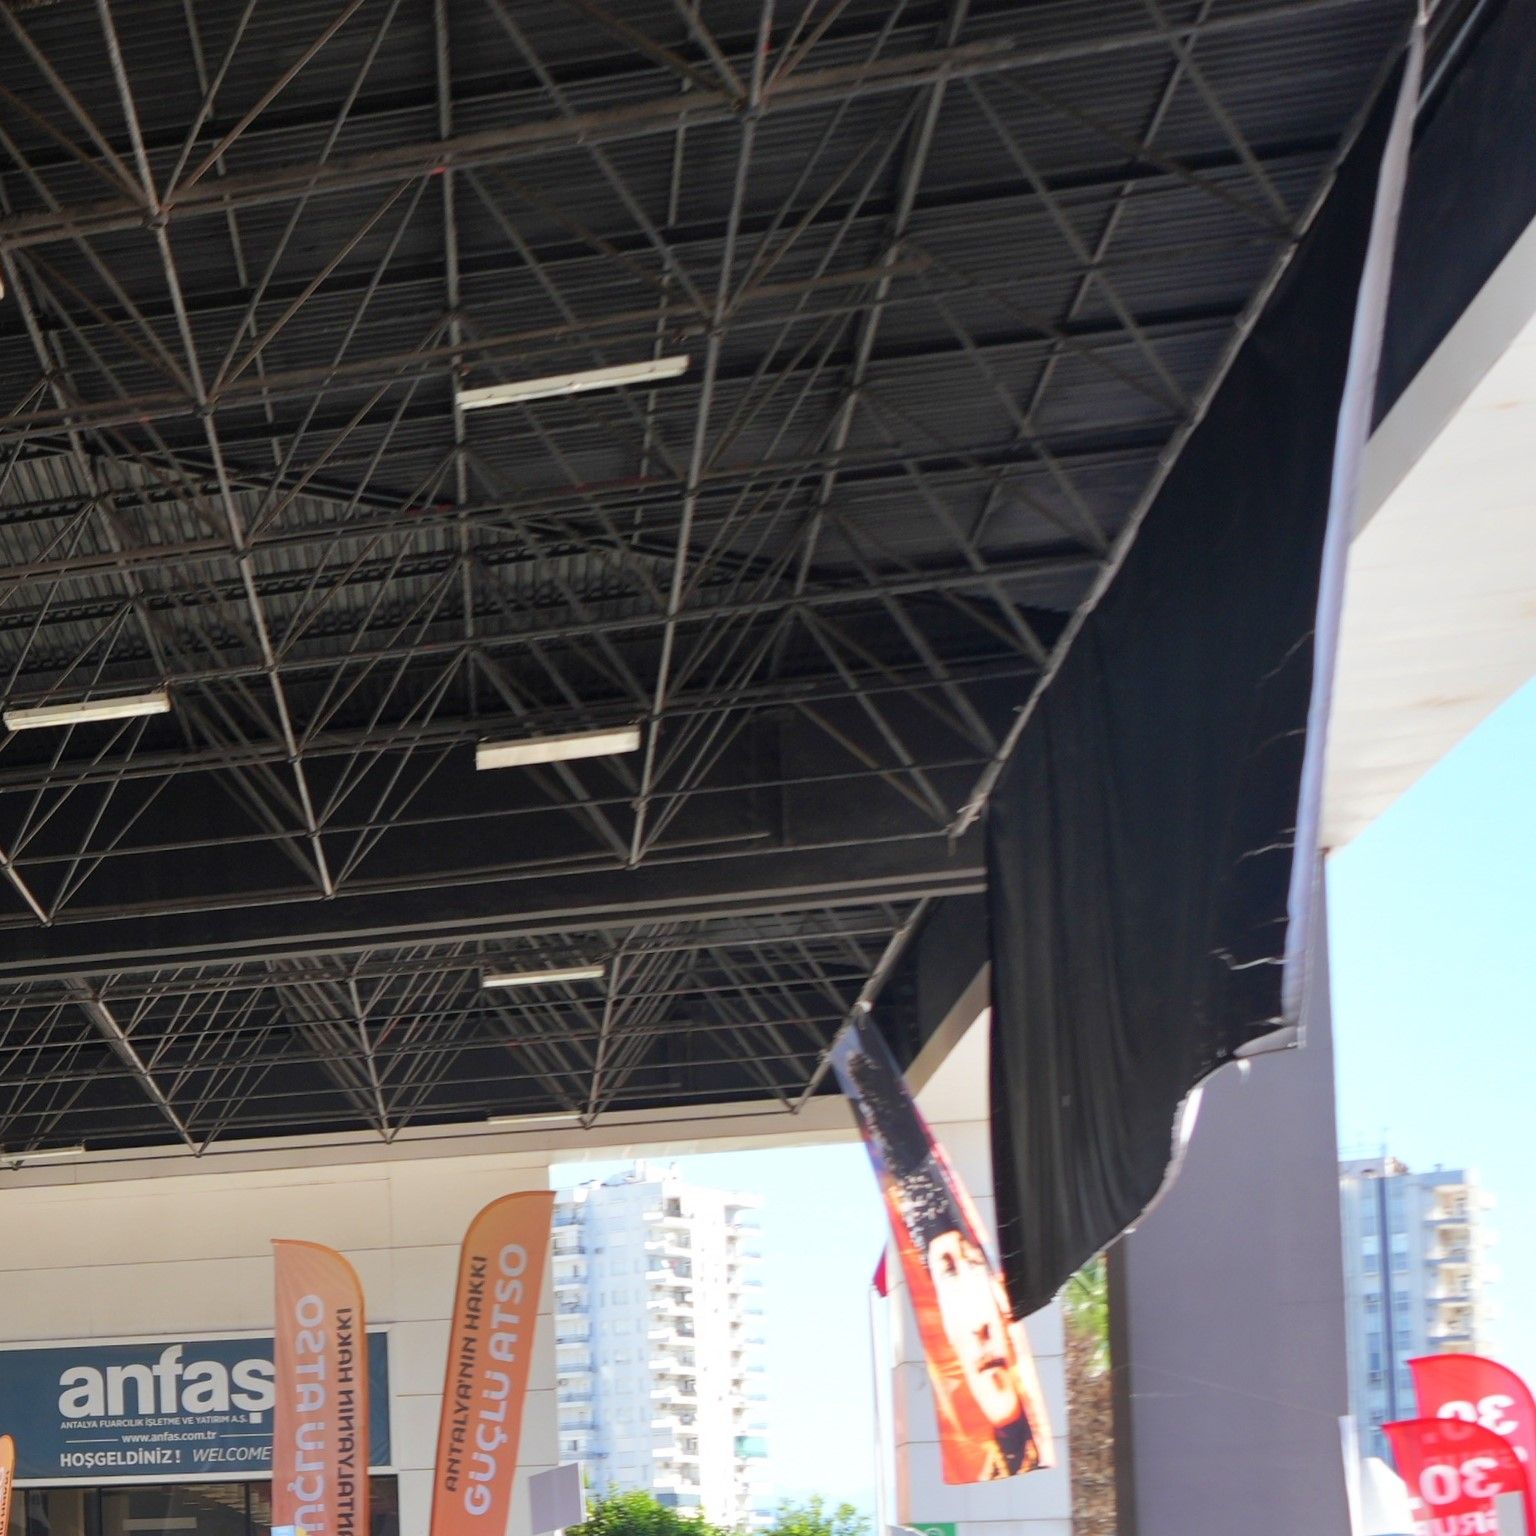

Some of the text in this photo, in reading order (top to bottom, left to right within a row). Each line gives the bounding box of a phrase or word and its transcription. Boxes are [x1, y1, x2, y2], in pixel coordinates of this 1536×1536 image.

[468, 1256, 489, 1331] HAKKI
[59, 1344, 276, 1424] anfaş
[464, 1243, 528, 1516] GÜÇLÜ ATSO
[60, 1421, 98, 1430] ANTALYA
[100, 1418, 143, 1428] FUARCILIK
[145, 1416, 180, 1427] İŞLETME
[182, 1416, 194, 1425] VE
[196, 1415, 228, 1425] YATIRIM
[121, 1431, 217, 1443] www.anfas.com.tr
[193, 1447, 272, 1462] WELCOME
